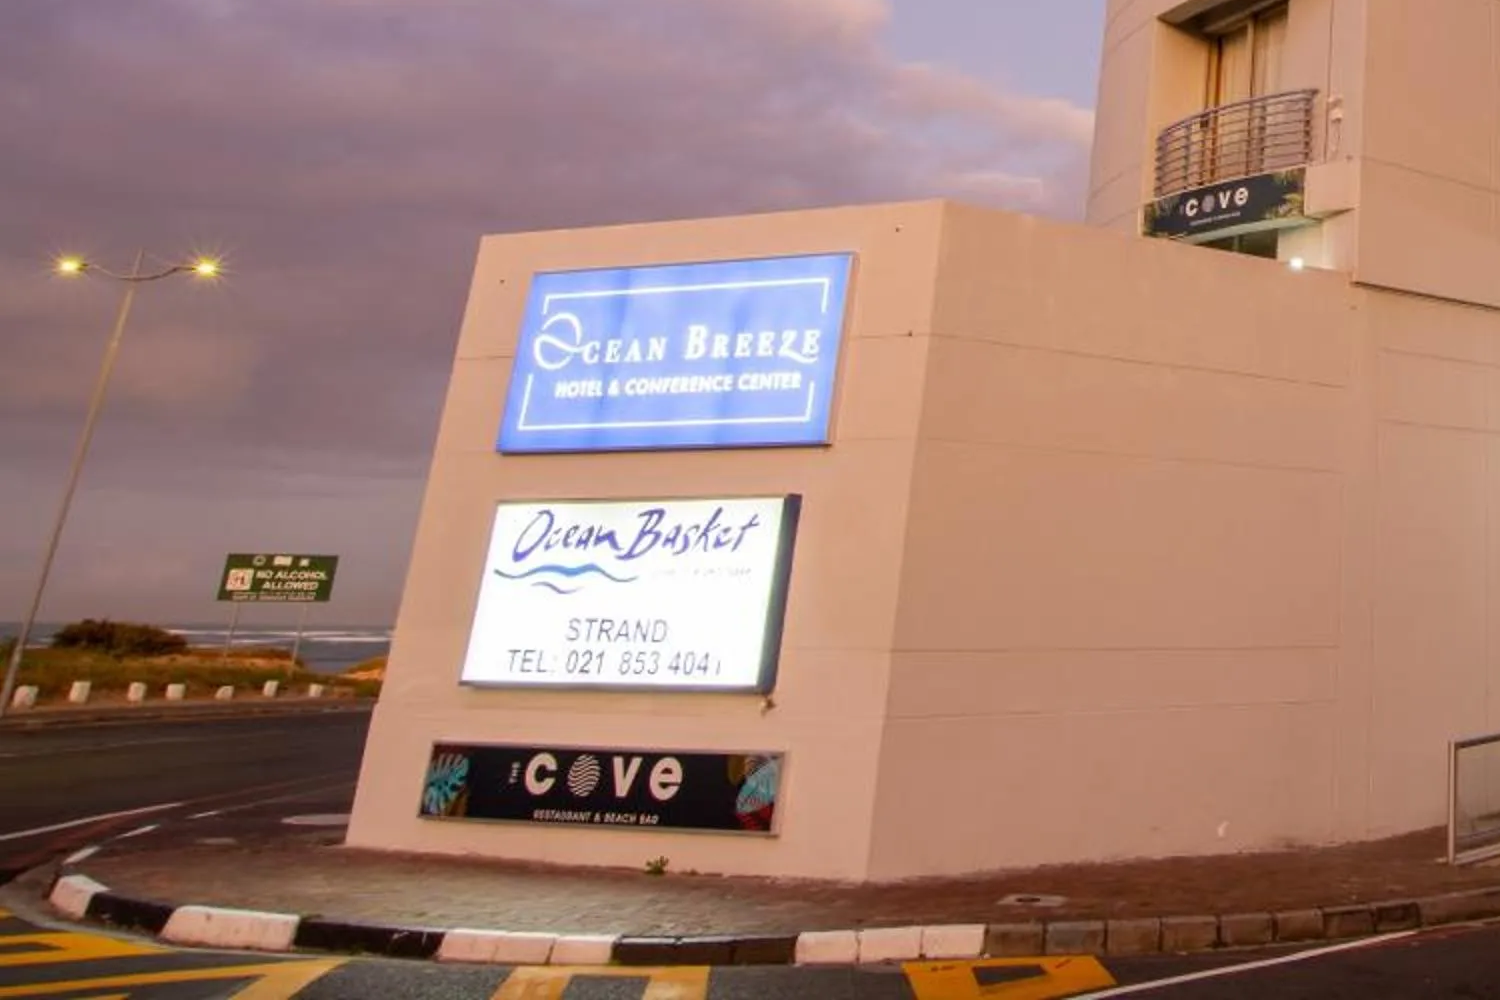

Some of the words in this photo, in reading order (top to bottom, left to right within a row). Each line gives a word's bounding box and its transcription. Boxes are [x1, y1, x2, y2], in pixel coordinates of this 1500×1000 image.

[554, 379, 603, 398] HOTEL
[608, 379, 619, 396] &
[624, 374, 733, 396] CONFERENCE
[738, 371, 802, 391] CENTER
[512, 509, 623, 562] Ocean
[614, 506, 760, 561] Basket
[256, 569, 274, 580] NO
[274, 570, 327, 580] ALCOHOL
[262, 581, 319, 590] ALLOWED
[565, 618, 669, 643] STRAND
[565, 650, 606, 674] 021
[618, 651, 661, 676] 853
[532, 808, 591, 823] RESTAURANT
[594, 810, 601, 823] &
[603, 810, 637, 824] BEACH
[639, 813, 660, 826] BAR
